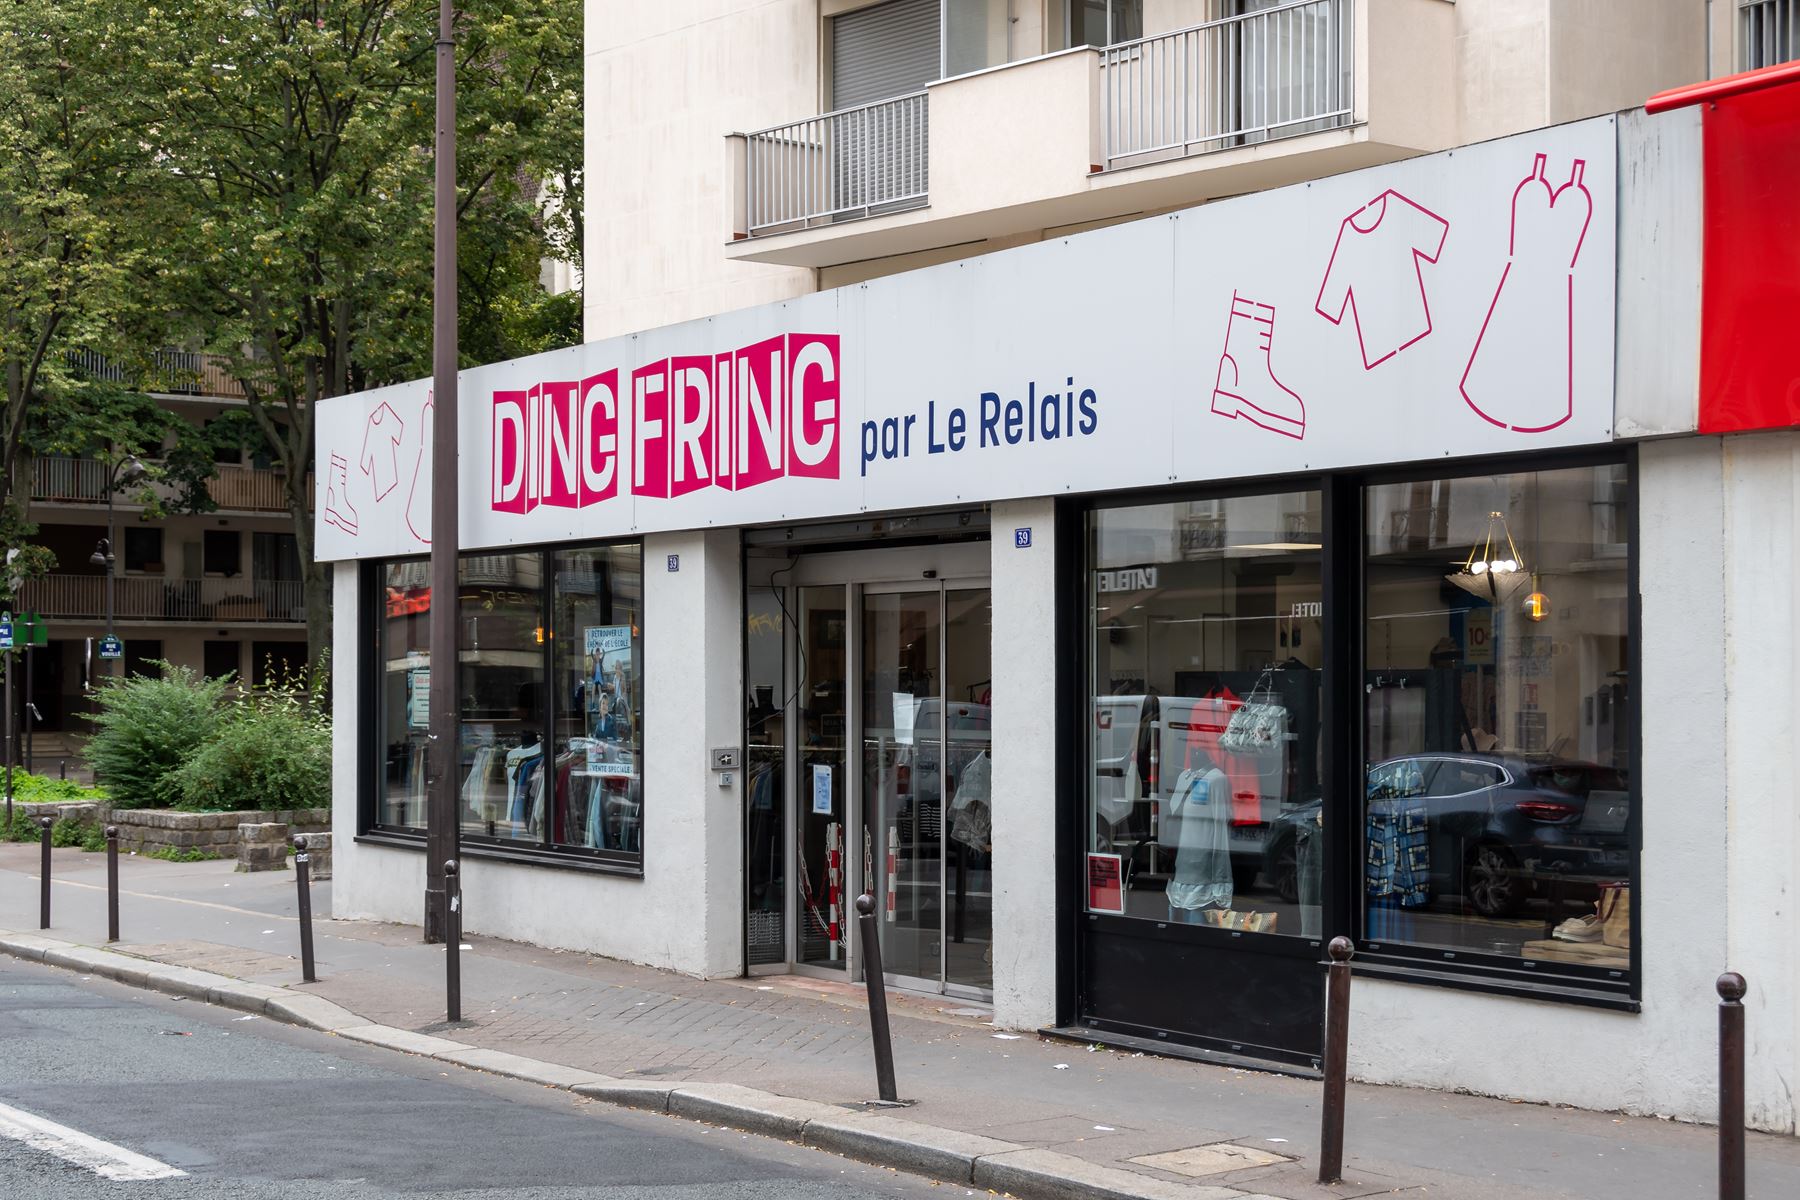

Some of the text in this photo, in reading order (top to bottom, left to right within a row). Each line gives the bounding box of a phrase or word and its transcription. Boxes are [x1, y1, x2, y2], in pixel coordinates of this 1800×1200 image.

[494, 341, 835, 503] DING FRING
[861, 376, 1098, 477] par Le Relais
[1018, 531, 1028, 545] 39
